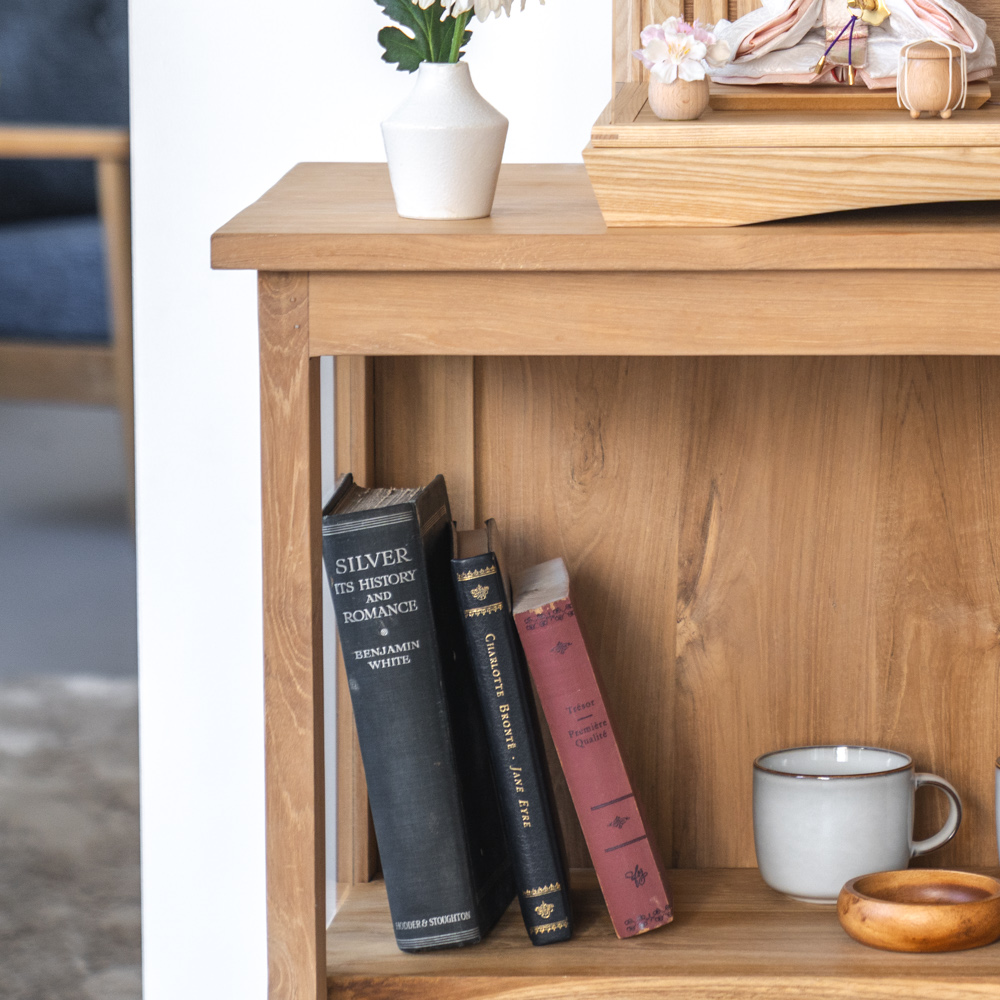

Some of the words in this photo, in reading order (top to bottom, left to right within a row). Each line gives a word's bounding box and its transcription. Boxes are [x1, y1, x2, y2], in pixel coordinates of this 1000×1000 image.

[335, 547, 413, 575] SILVER
[334, 581, 355, 595] ITS
[358, 569, 417, 592] HISTORY
[366, 591, 392, 604] AND
[342, 600, 418, 624] ROMANCE
[353, 640, 420, 660] BENJAMIN
[367, 655, 411, 670] WHITE
[485, 633, 505, 698] CHARLOTTE
[509, 765, 525, 793] JANE
[518, 799, 532, 828] EYRE
[575, 730, 608, 748] Qualité
[395, 919, 421, 931] HODDER
[421, 918, 428, 928] &
[428, 911, 471, 927] STOUGHTON
